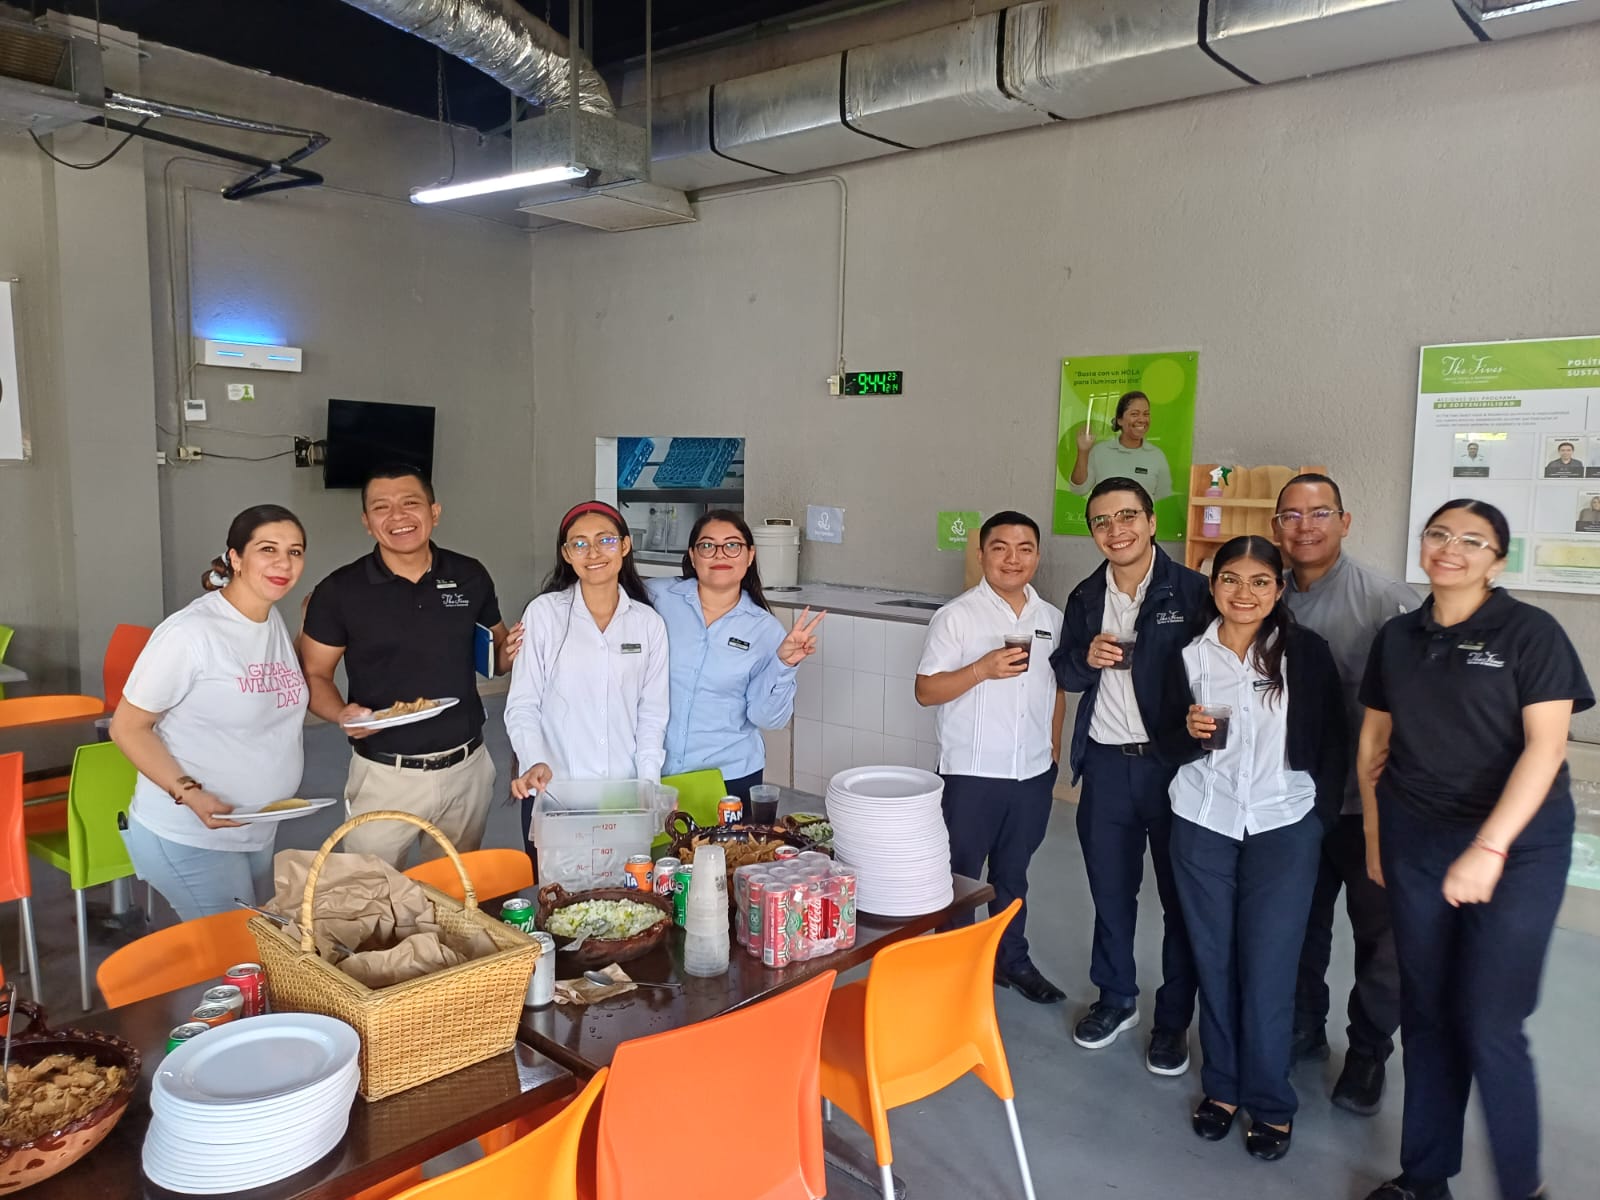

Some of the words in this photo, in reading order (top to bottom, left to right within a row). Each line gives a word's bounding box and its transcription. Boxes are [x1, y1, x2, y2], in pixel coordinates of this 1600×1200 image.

[1441, 355, 1466, 376] The
[1468, 354, 1504, 375] Fives
[858, 373, 886, 394] 9:44
[276, 688, 302, 709] DAY
